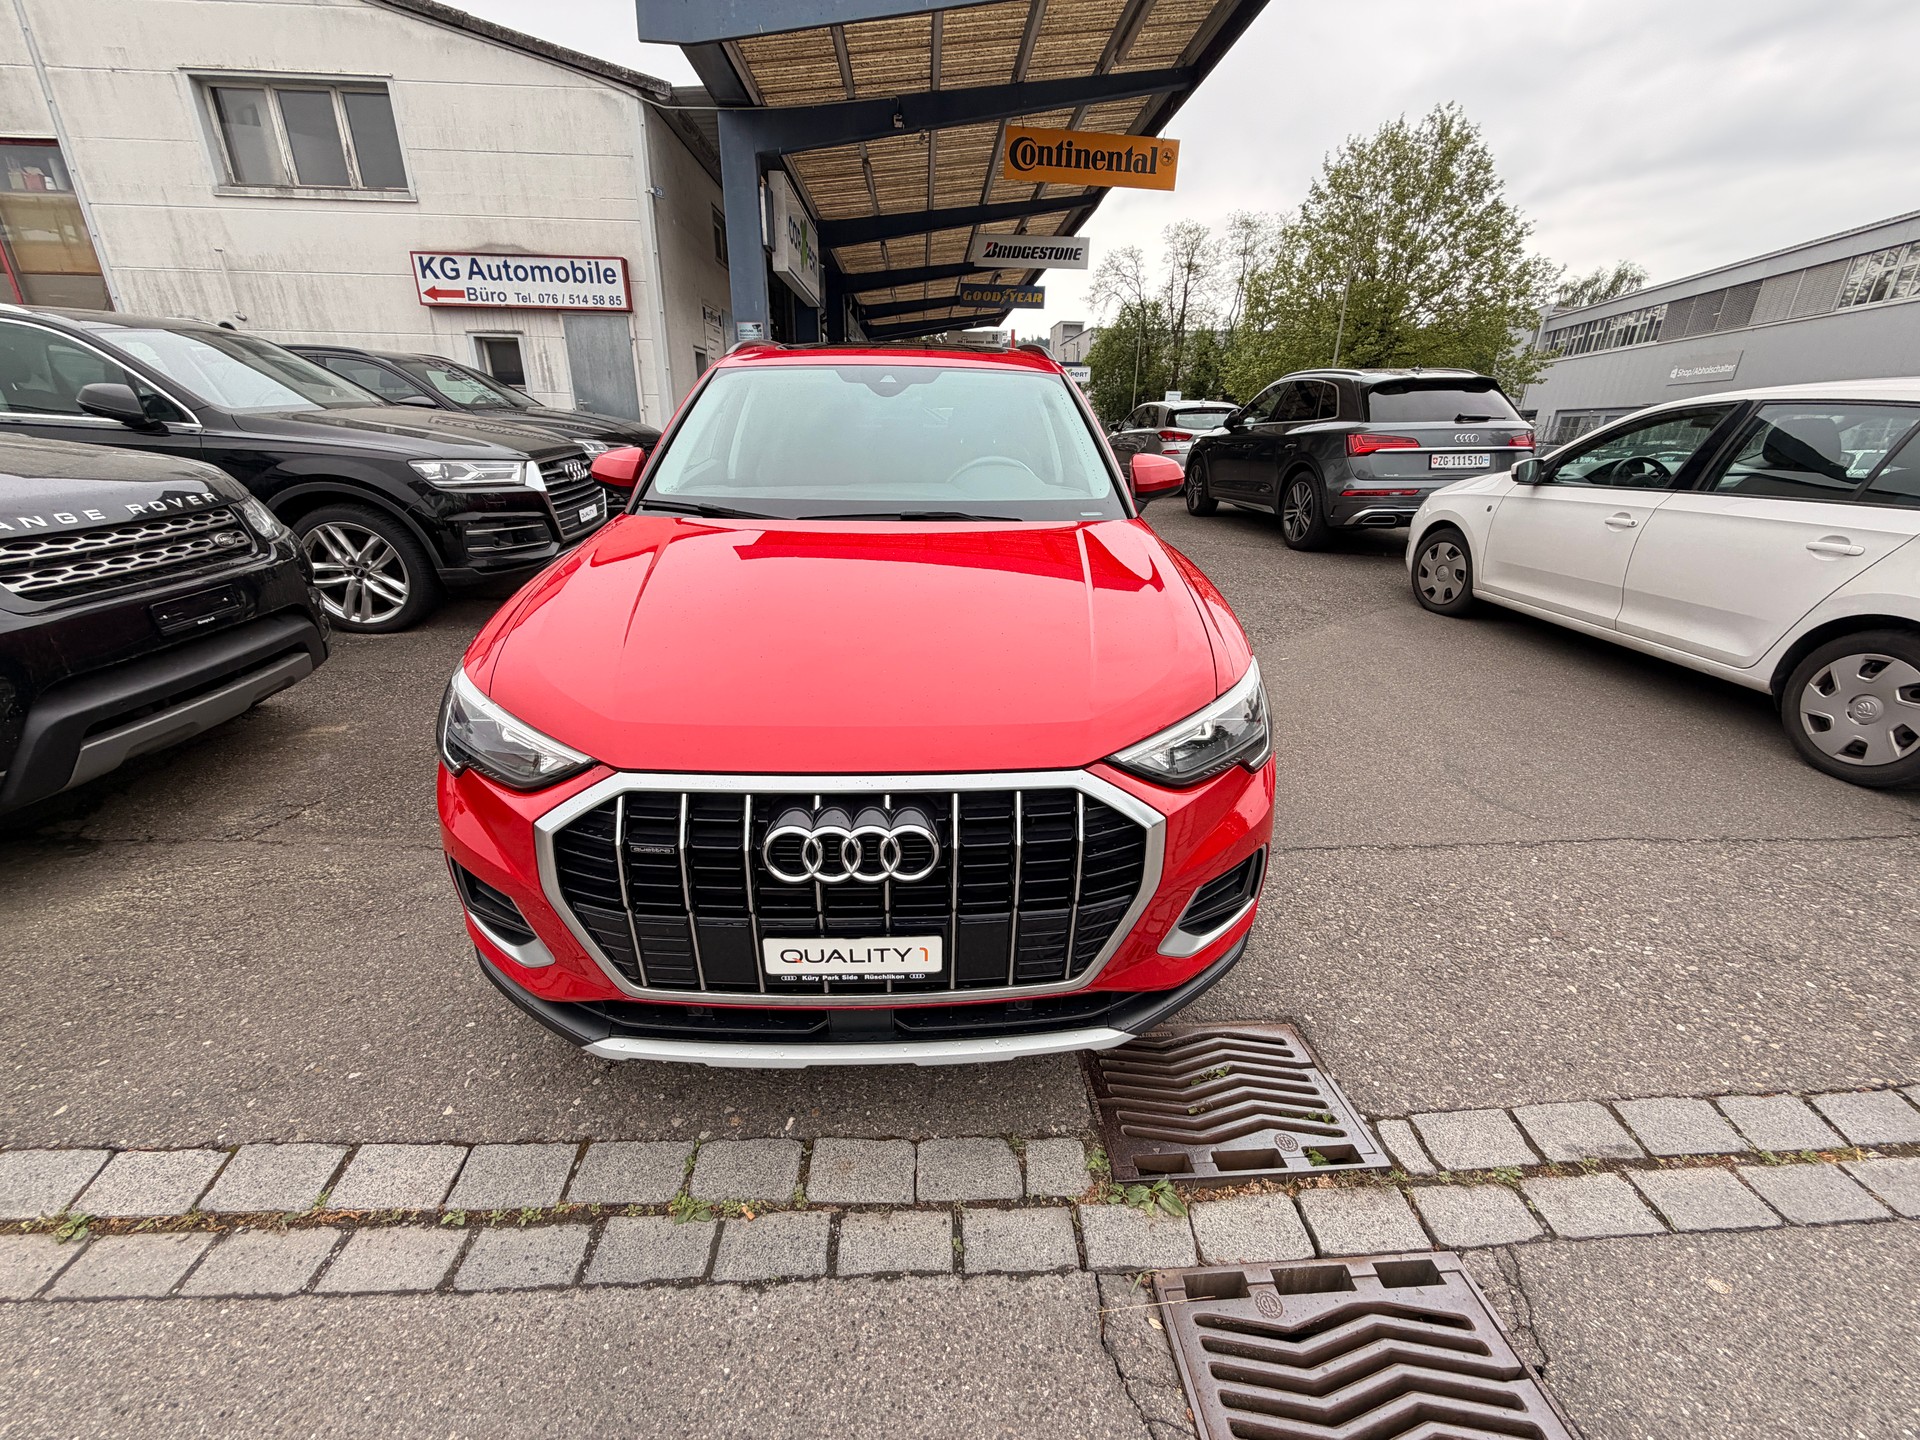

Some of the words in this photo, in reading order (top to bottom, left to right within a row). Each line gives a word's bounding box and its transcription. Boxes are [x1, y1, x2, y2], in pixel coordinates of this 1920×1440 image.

[1009, 136, 1157, 174] Continental
[982, 241, 1083, 261] BRIDGESTONE
[417, 255, 461, 281] KG
[468, 257, 617, 285] Automobile
[466, 286, 507, 303] Büro
[514, 292, 535, 304] Tel.
[538, 292, 559, 304] 076
[568, 294, 588, 305] 514
[592, 295, 606, 306] 58
[608, 295, 622, 306] 85
[125, 492, 219, 515] ROVER
[780, 947, 912, 964] QUALITY
[802, 974, 819, 982] Küry
[865, 973, 905, 981] Rüschlikon
